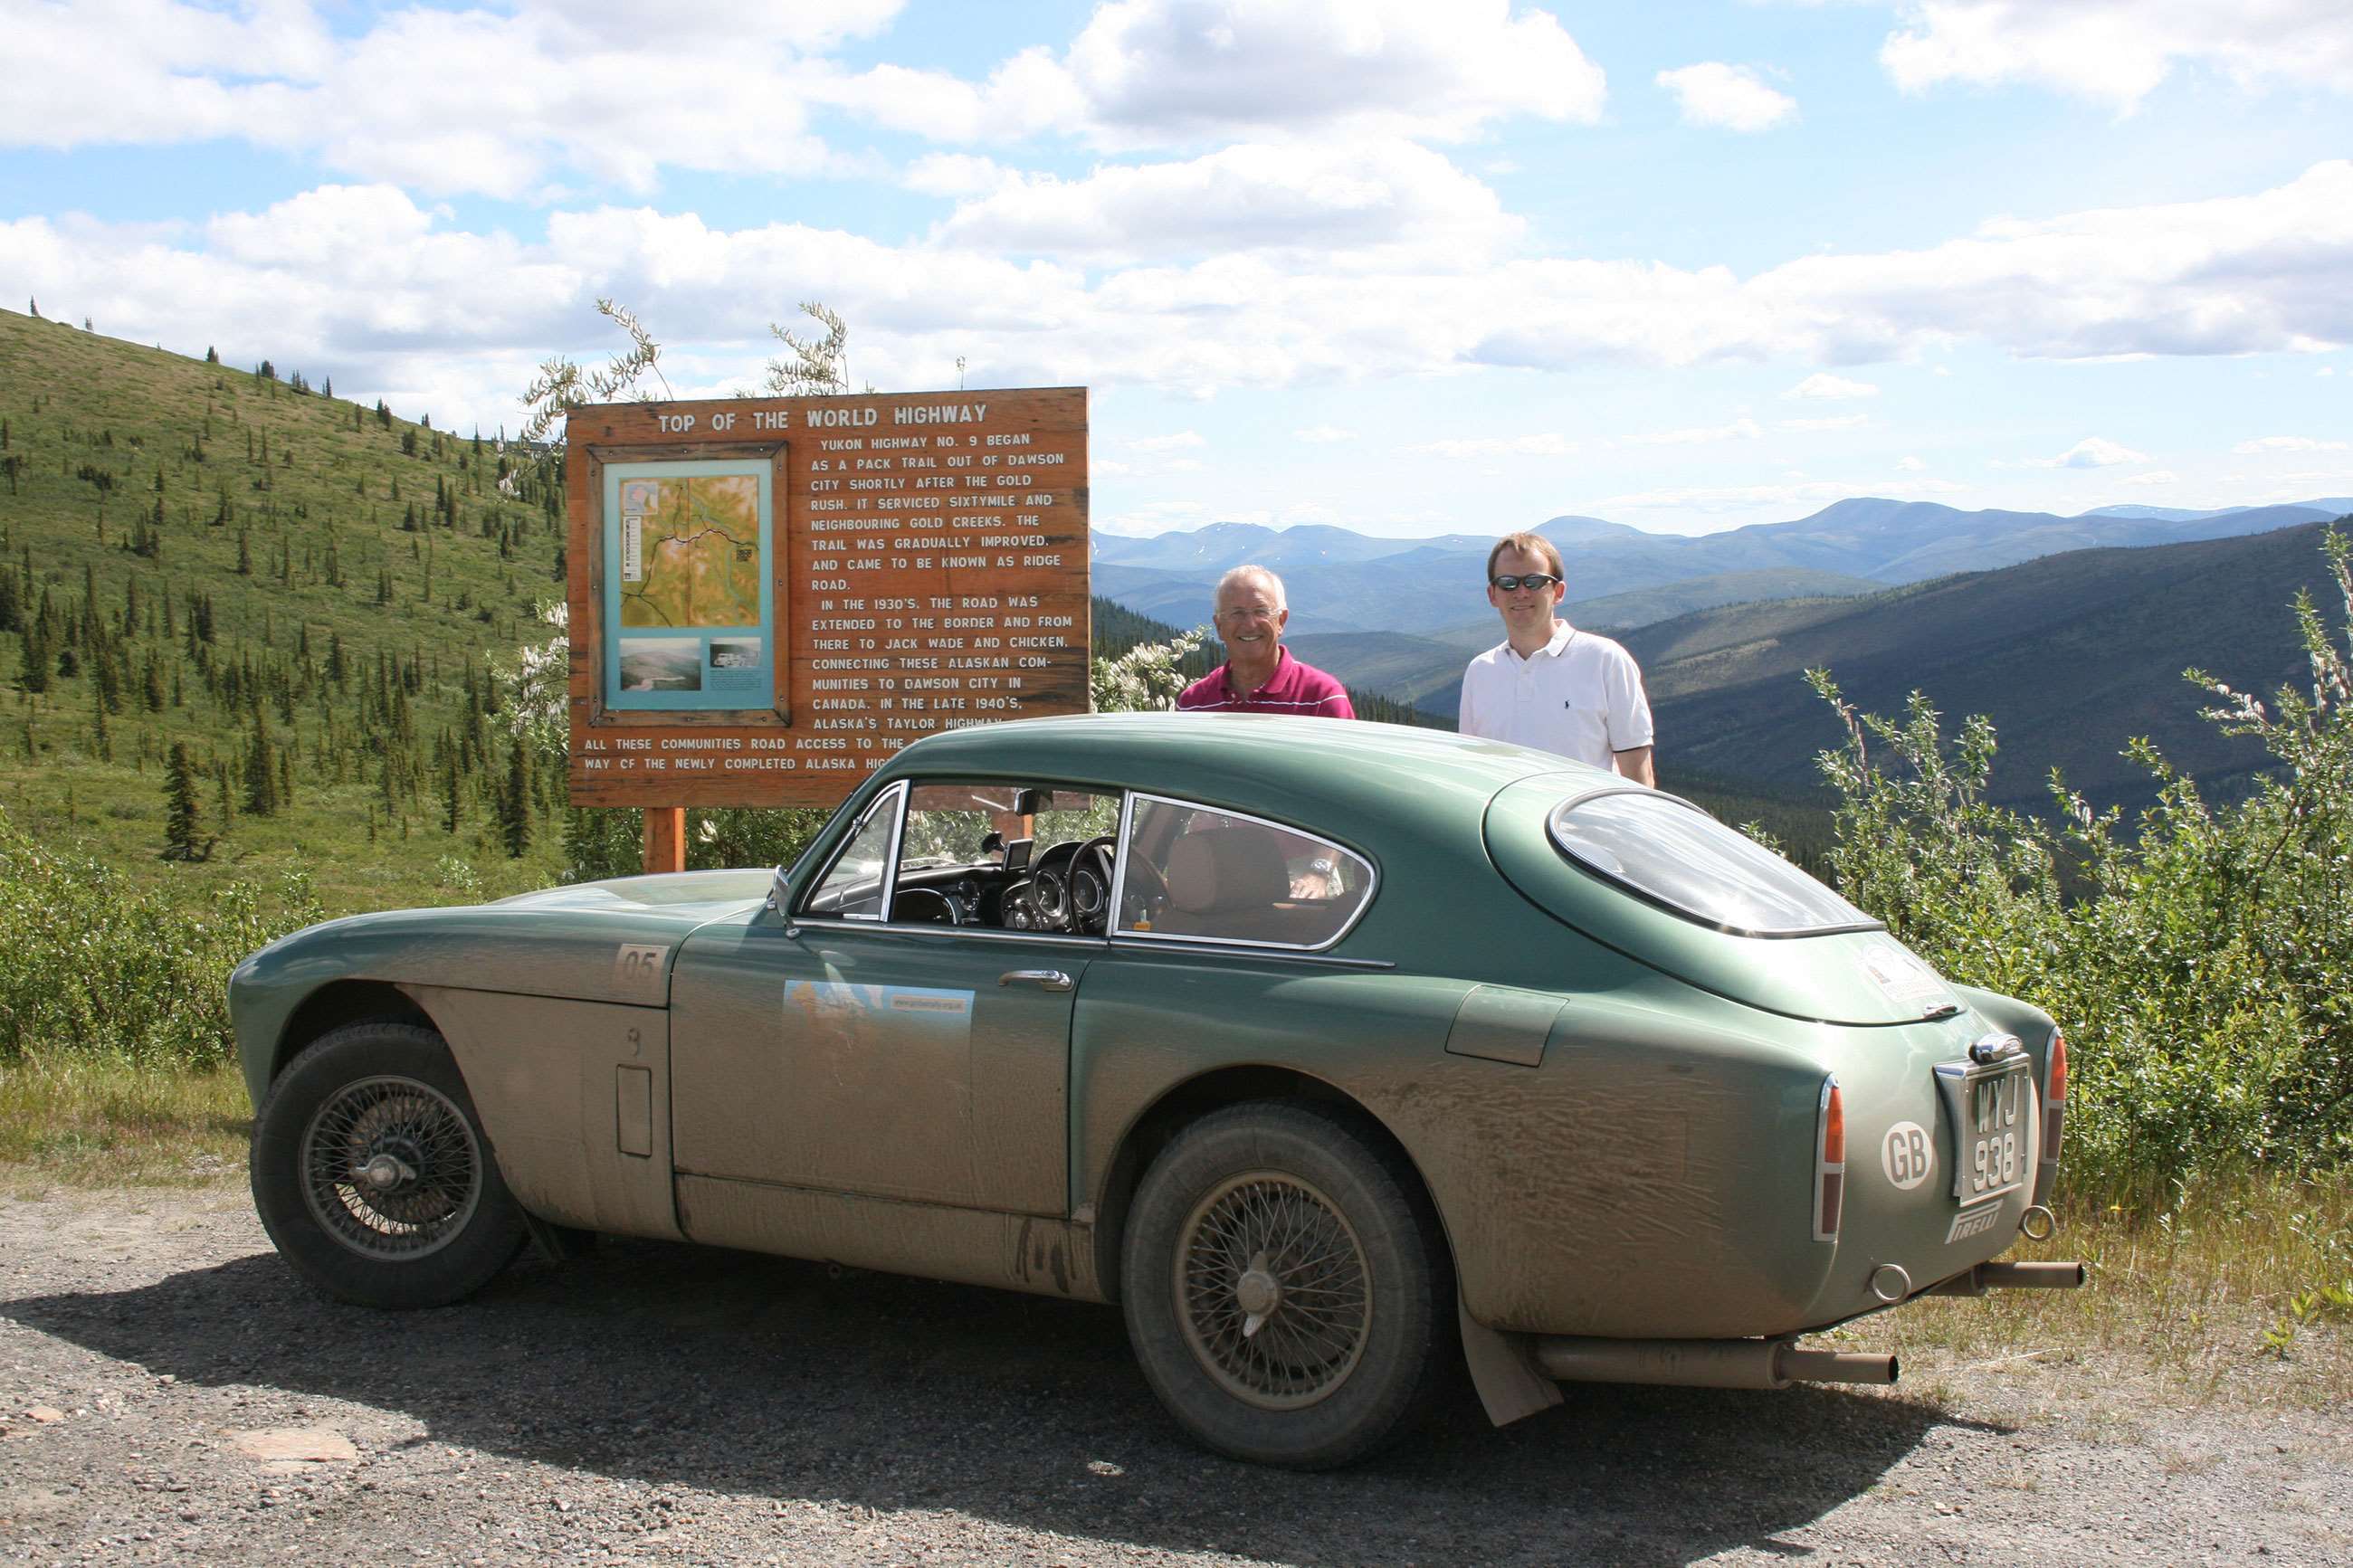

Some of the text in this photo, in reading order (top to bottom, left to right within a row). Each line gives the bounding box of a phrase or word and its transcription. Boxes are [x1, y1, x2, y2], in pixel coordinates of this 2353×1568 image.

[658, 404, 986, 432] TOP OF THE WORLD HIGHWAY
[821, 433, 1030, 451] YUKON HIGHWAY NO. 9 BEGAN
[811, 453, 1064, 471] AS A PACK TRAIL OUT OF DAWSON
[810, 474, 1032, 491] CITY SHORTLY AFTER THE GOLD
[810, 493, 1053, 511] RUSH. IT SERVICED SIXTYMILE AND
[811, 515, 1039, 531] NEIGHBOURING GOLD CREEKS. THE
[811, 539, 847, 551] TRAIL
[856, 538, 885, 550] WAS
[894, 537, 970, 549] GRADUALLY
[812, 555, 1061, 571] AND CAME TO BE KNOWN AS RIDGE
[811, 578, 851, 591] ROAD.
[821, 600, 834, 611] IN
[843, 599, 865, 610] THE
[929, 597, 952, 609] THE
[962, 597, 998, 609] ROAD
[1008, 595, 1038, 608] WAS
[812, 615, 1072, 631] EXTENDED TO THE BORDER AND FROM
[813, 639, 849, 651] THERE
[859, 638, 875, 650] TO
[885, 638, 918, 650] JACK
[928, 637, 964, 649] WADE
[974, 637, 1000, 649] AND
[812, 656, 1052, 670] CONNECTING THESE ALASKAN COM-
[812, 677, 1021, 690] MUNITIES TO DAWSON CITY IN
[813, 698, 871, 710] CANADA.
[880, 698, 892, 709] IN
[901, 698, 924, 709] THE
[933, 698, 966, 709] LATE
[814, 716, 877, 729] ALASKA'S
[887, 717, 935, 729] TAYLOR
[585, 739, 606, 750] ALL
[615, 738, 652, 750] THESE
[661, 738, 741, 749] COMMUNITIES
[751, 738, 786, 749] ROAD
[795, 737, 846, 749] ACCESS
[856, 737, 872, 749] TO
[881, 737, 904, 749] THE
[585, 759, 610, 769] WAY
[643, 758, 666, 769] THE
[675, 758, 715, 769] NEWLY
[725, 758, 795, 769] COMPLETED
[805, 758, 855, 769] ALASKA
[1977, 1074, 2019, 1134] WYJ
[1888, 1129, 1927, 1183] GB
[1973, 1132, 2015, 1193] 938
[1943, 1198, 2005, 1245] PIRELLI
